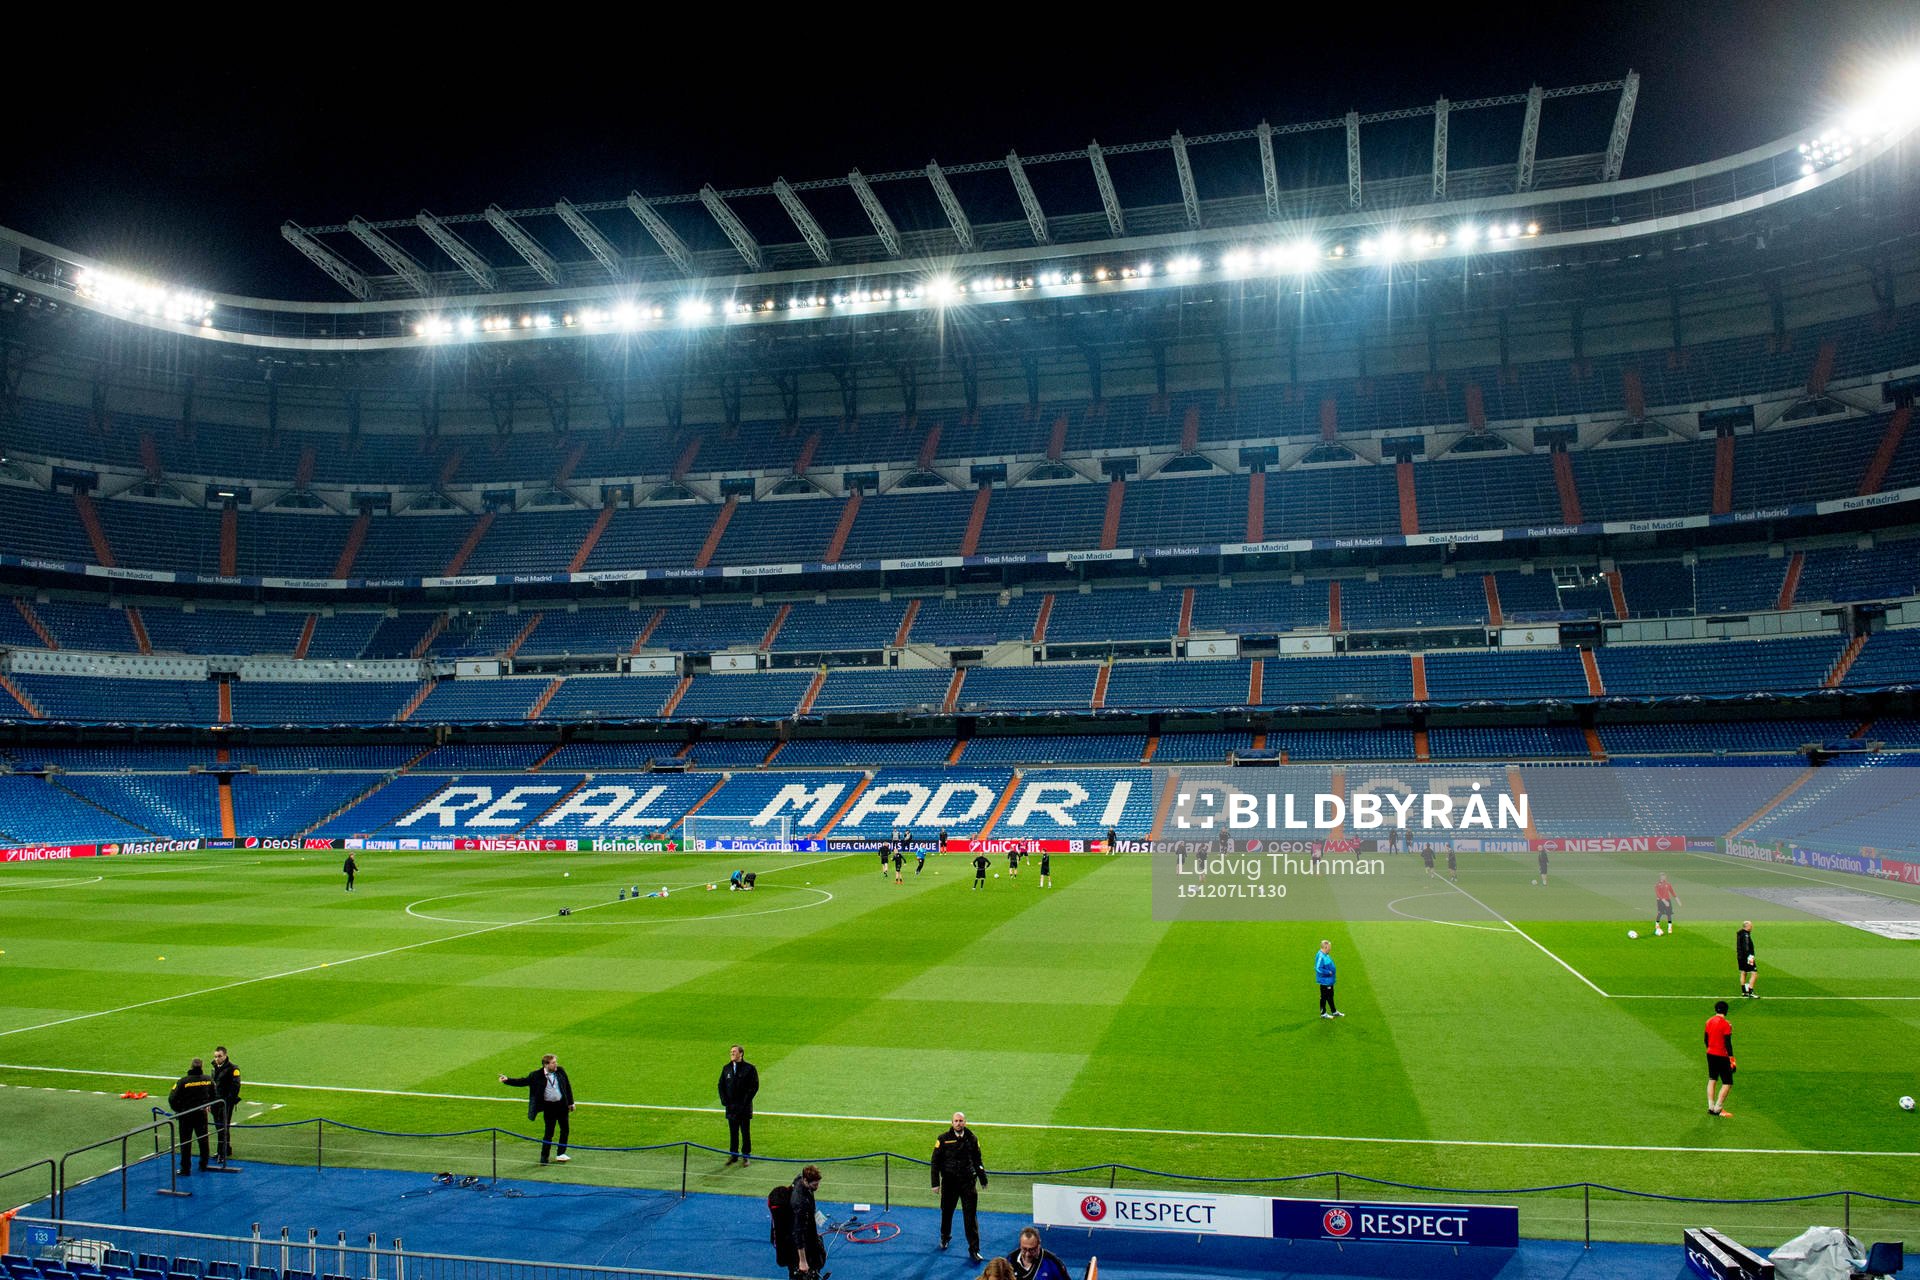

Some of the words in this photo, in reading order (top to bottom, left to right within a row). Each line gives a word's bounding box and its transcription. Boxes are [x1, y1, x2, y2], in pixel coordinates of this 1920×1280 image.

[1844, 500, 1864, 510] Real
[1866, 494, 1900, 506] Madrid
[1734, 512, 1755, 521] Real
[1757, 508, 1788, 518] Madrid
[1528, 528, 1544, 536] Real
[1546, 526, 1578, 536] Madrid
[1630, 523, 1650, 532] Real
[1652, 521, 1684, 530] Madrid
[1336, 539, 1352, 547] Real
[1354, 538, 1382, 546] Madrid
[1429, 536, 1448, 544] Real
[1450, 534, 1478, 542] Madrid
[1156, 548, 1172, 556] Real
[1173, 546, 1200, 555] Madrid
[1260, 544, 1288, 552] Madrid
[984, 556, 1000, 564] Real
[1086, 552, 1112, 560] Madrid
[21, 559, 38, 568] Real
[39, 560, 65, 570] Madrid
[822, 563, 838, 571] Real
[839, 562, 862, 570] Madrid
[918, 560, 942, 568] Madrid
[108, 568, 125, 578] Real
[126, 570, 153, 580] Madrid
[666, 570, 681, 578] Real
[682, 568, 704, 576] Madrid
[759, 566, 782, 574] Madrid
[214, 576, 242, 584] Madrid
[530, 574, 552, 582] Madrid
[605, 572, 628, 580] Madrid
[302, 580, 328, 588] Madrid
[382, 578, 404, 586] Madrid
[456, 578, 478, 586] Madrid
[395, 786, 672, 827] REAL
[749, 780, 1242, 827] MADRID
[122, 839, 200, 855] MasterCard
[262, 838, 300, 849] pepsi
[304, 839, 335, 849] MAX
[366, 841, 396, 850] GAZPROM
[422, 841, 452, 850] GAZPROM
[480, 841, 540, 851] NISSAN
[592, 840, 662, 852] Heineken
[732, 841, 800, 853] PlayStation
[830, 842, 851, 850] UEFA
[853, 842, 902, 850] CHAMPNS
[904, 842, 936, 850] EAGUE
[1268, 842, 1313, 852] peps
[1409, 842, 1450, 852] AZPROM
[1484, 842, 1528, 852] GAZPROM
[1564, 840, 1648, 852] NISSAN
[20, 847, 71, 861] UniCredit
[1726, 839, 1772, 862] Heineken
[1812, 852, 1862, 872] PlayStation
[1086, 1196, 1102, 1204] UEFA
[1115, 1201, 1216, 1224] RESPECT
[1329, 1209, 1346, 1218] UEFA
[1360, 1214, 1468, 1236] RESPECT
[34, 1232, 48, 1242] 133
